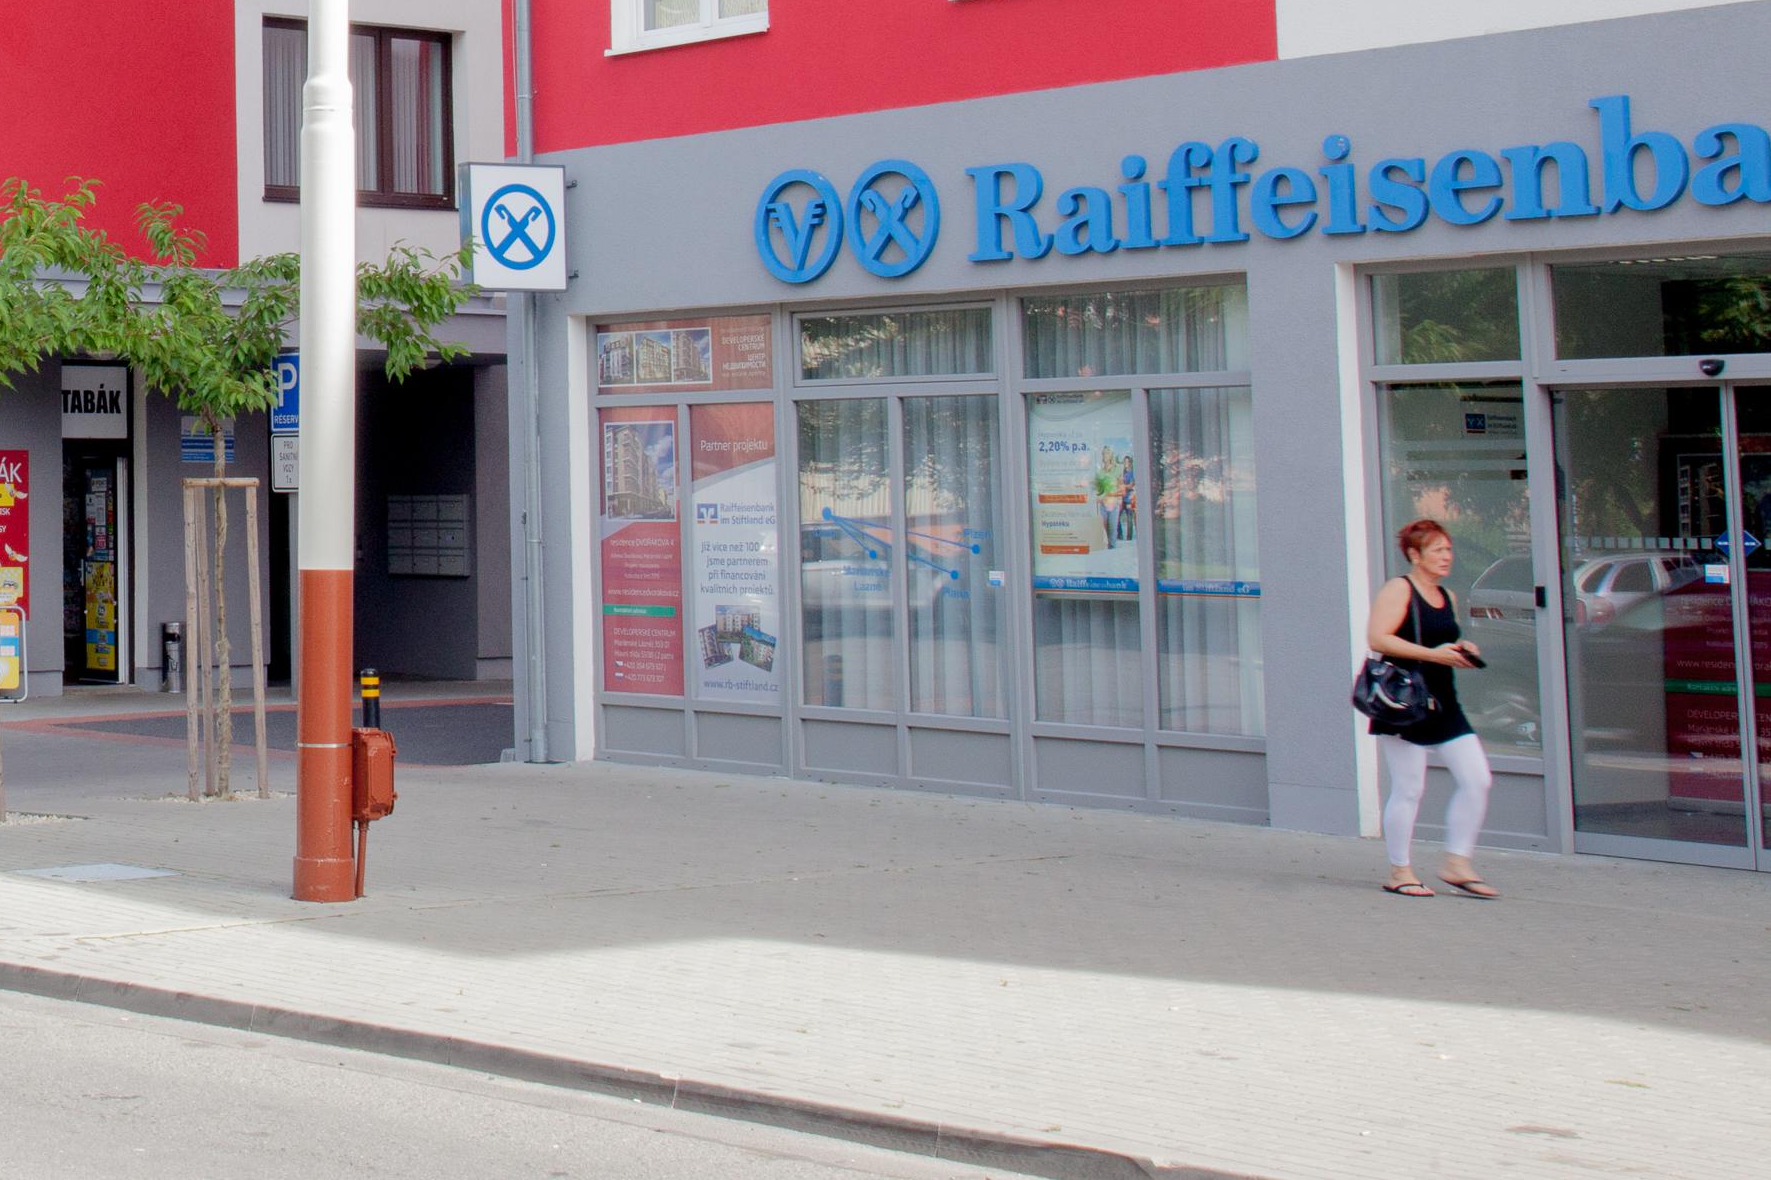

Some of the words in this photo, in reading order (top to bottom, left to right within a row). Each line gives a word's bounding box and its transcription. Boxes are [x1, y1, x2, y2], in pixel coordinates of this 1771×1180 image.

[277, 362, 298, 407] P
[61, 384, 121, 414] TABÁK
[283, 440, 294, 449] PRO
[700, 440, 732, 451] Partner
[733, 438, 768, 453] projektu
[1039, 441, 1070, 453] 2,20%
[1071, 441, 1090, 453] p.a.
[720, 500, 775, 513] Raiffeisenbank
[731, 515, 765, 525] Stiftland
[745, 541, 760, 552] 100
[706, 556, 726, 568] jsme
[726, 557, 769, 567] partnerem
